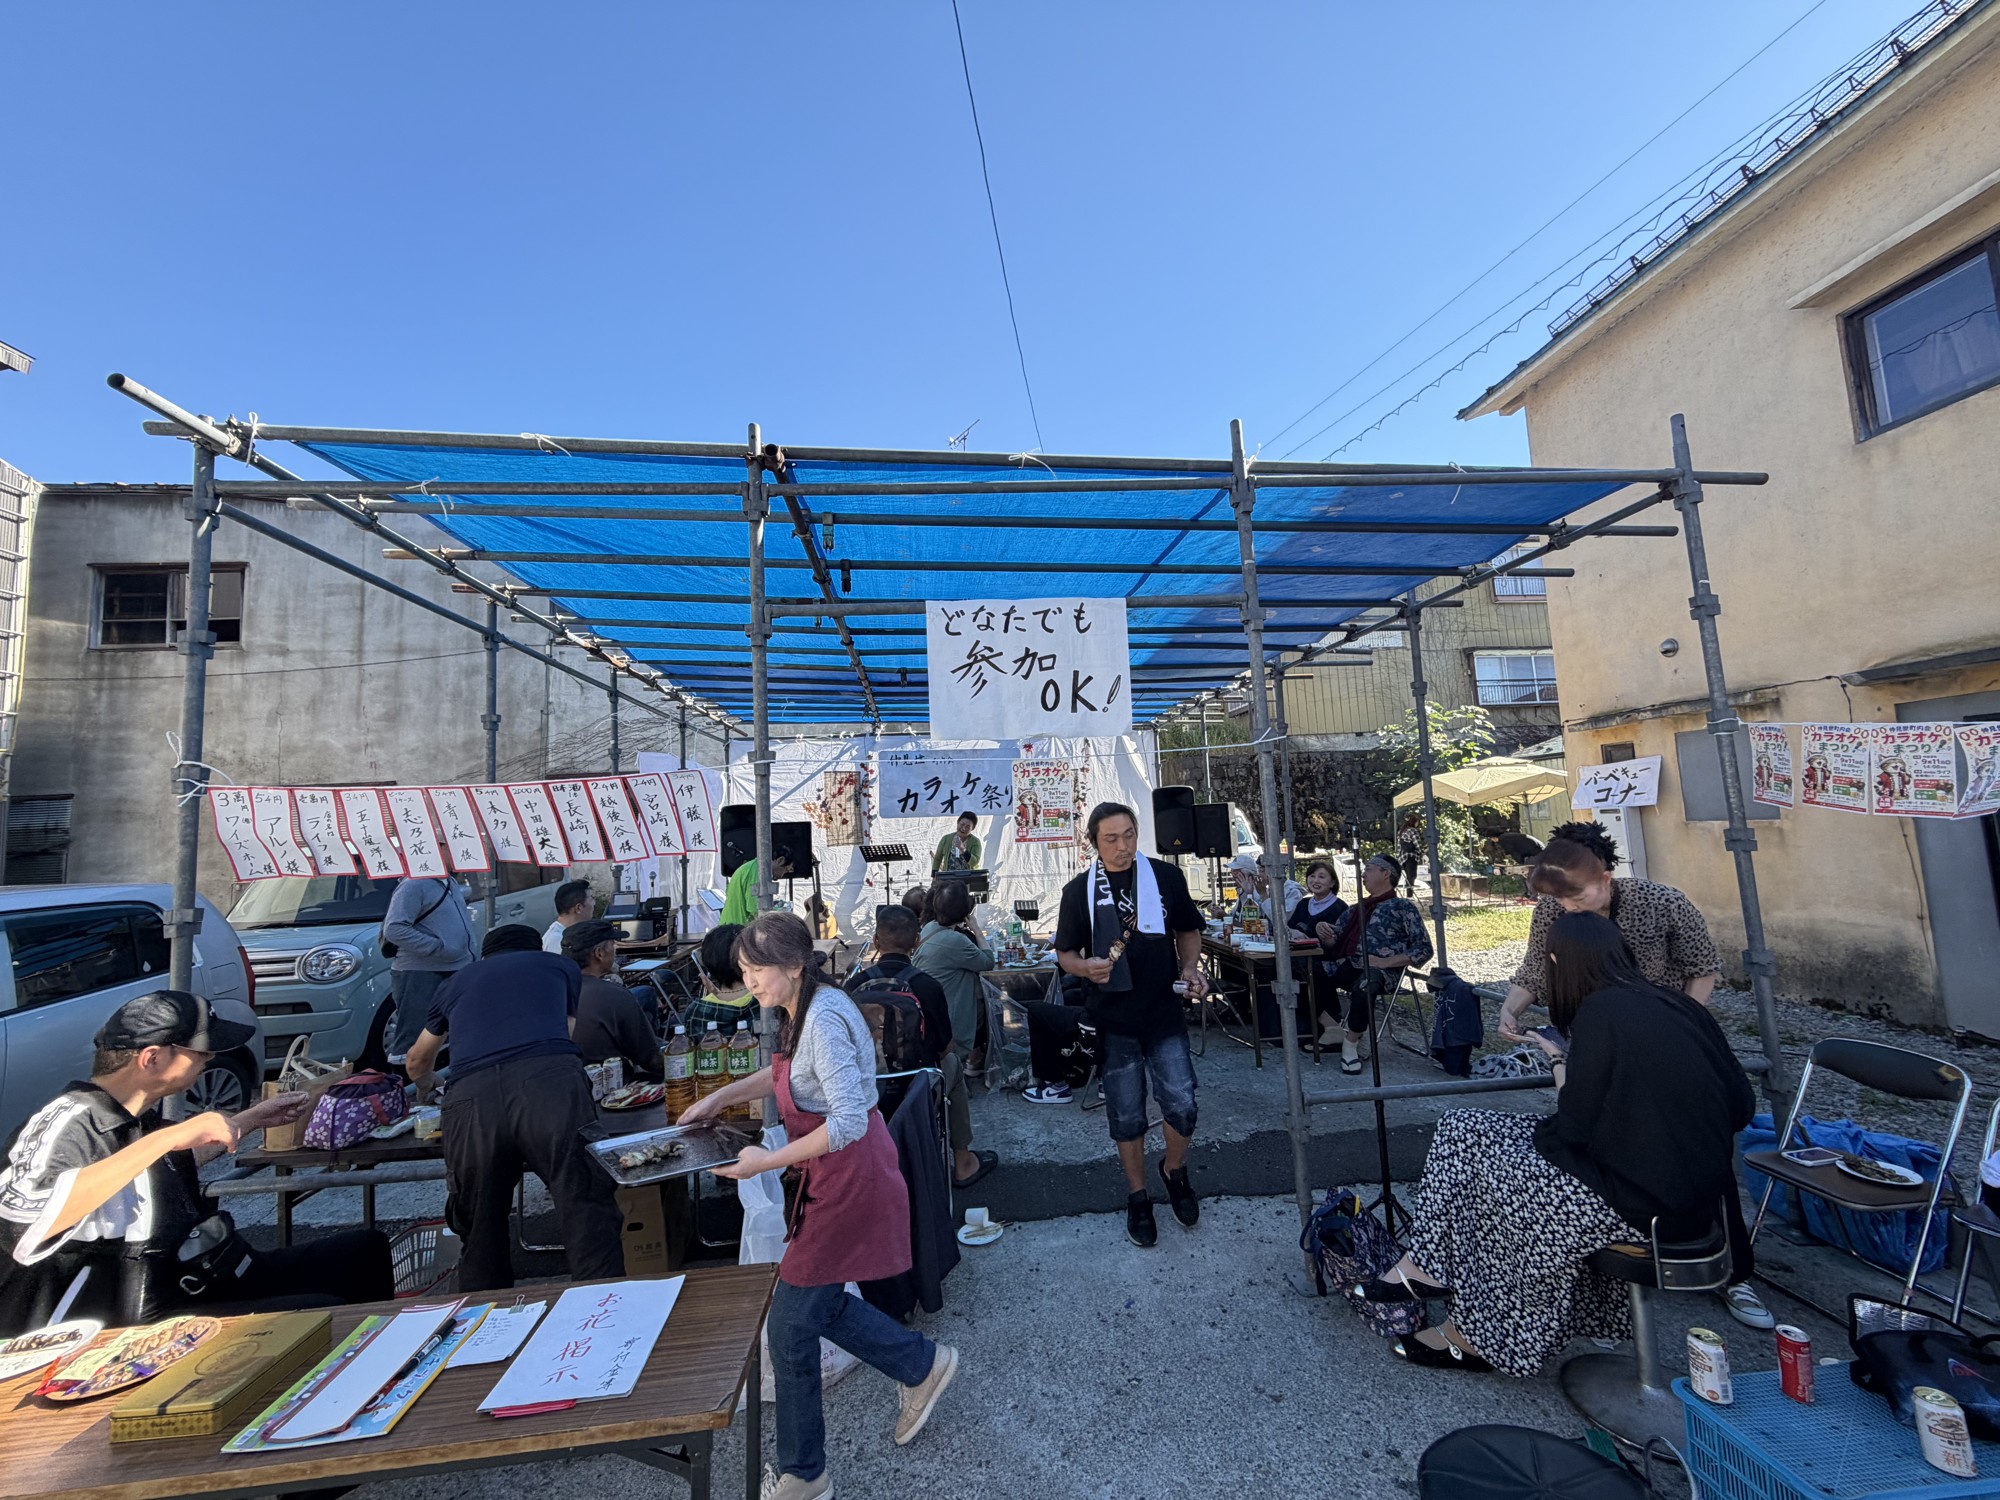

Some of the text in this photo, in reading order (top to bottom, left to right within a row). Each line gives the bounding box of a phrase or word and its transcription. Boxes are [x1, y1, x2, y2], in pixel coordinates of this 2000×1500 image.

[941, 602, 1092, 636] どなたでも
[950, 640, 1056, 700] 参加
[1040, 670, 1122, 714] OK!
[1756, 732, 1788, 743] カラオケ
[1811, 732, 1859, 743] カラオケ
[1881, 732, 1942, 744] カラオケ
[1818, 742, 1849, 753] まつり
[1893, 743, 1932, 754] まつり
[1020, 767, 1062, 778] カラオケ
[1584, 766, 1651, 786] バーベキュー
[1028, 777, 1055, 787] まつり
[1594, 782, 1646, 805] コーナー
[539, 1292, 623, 1388] お花掲示
